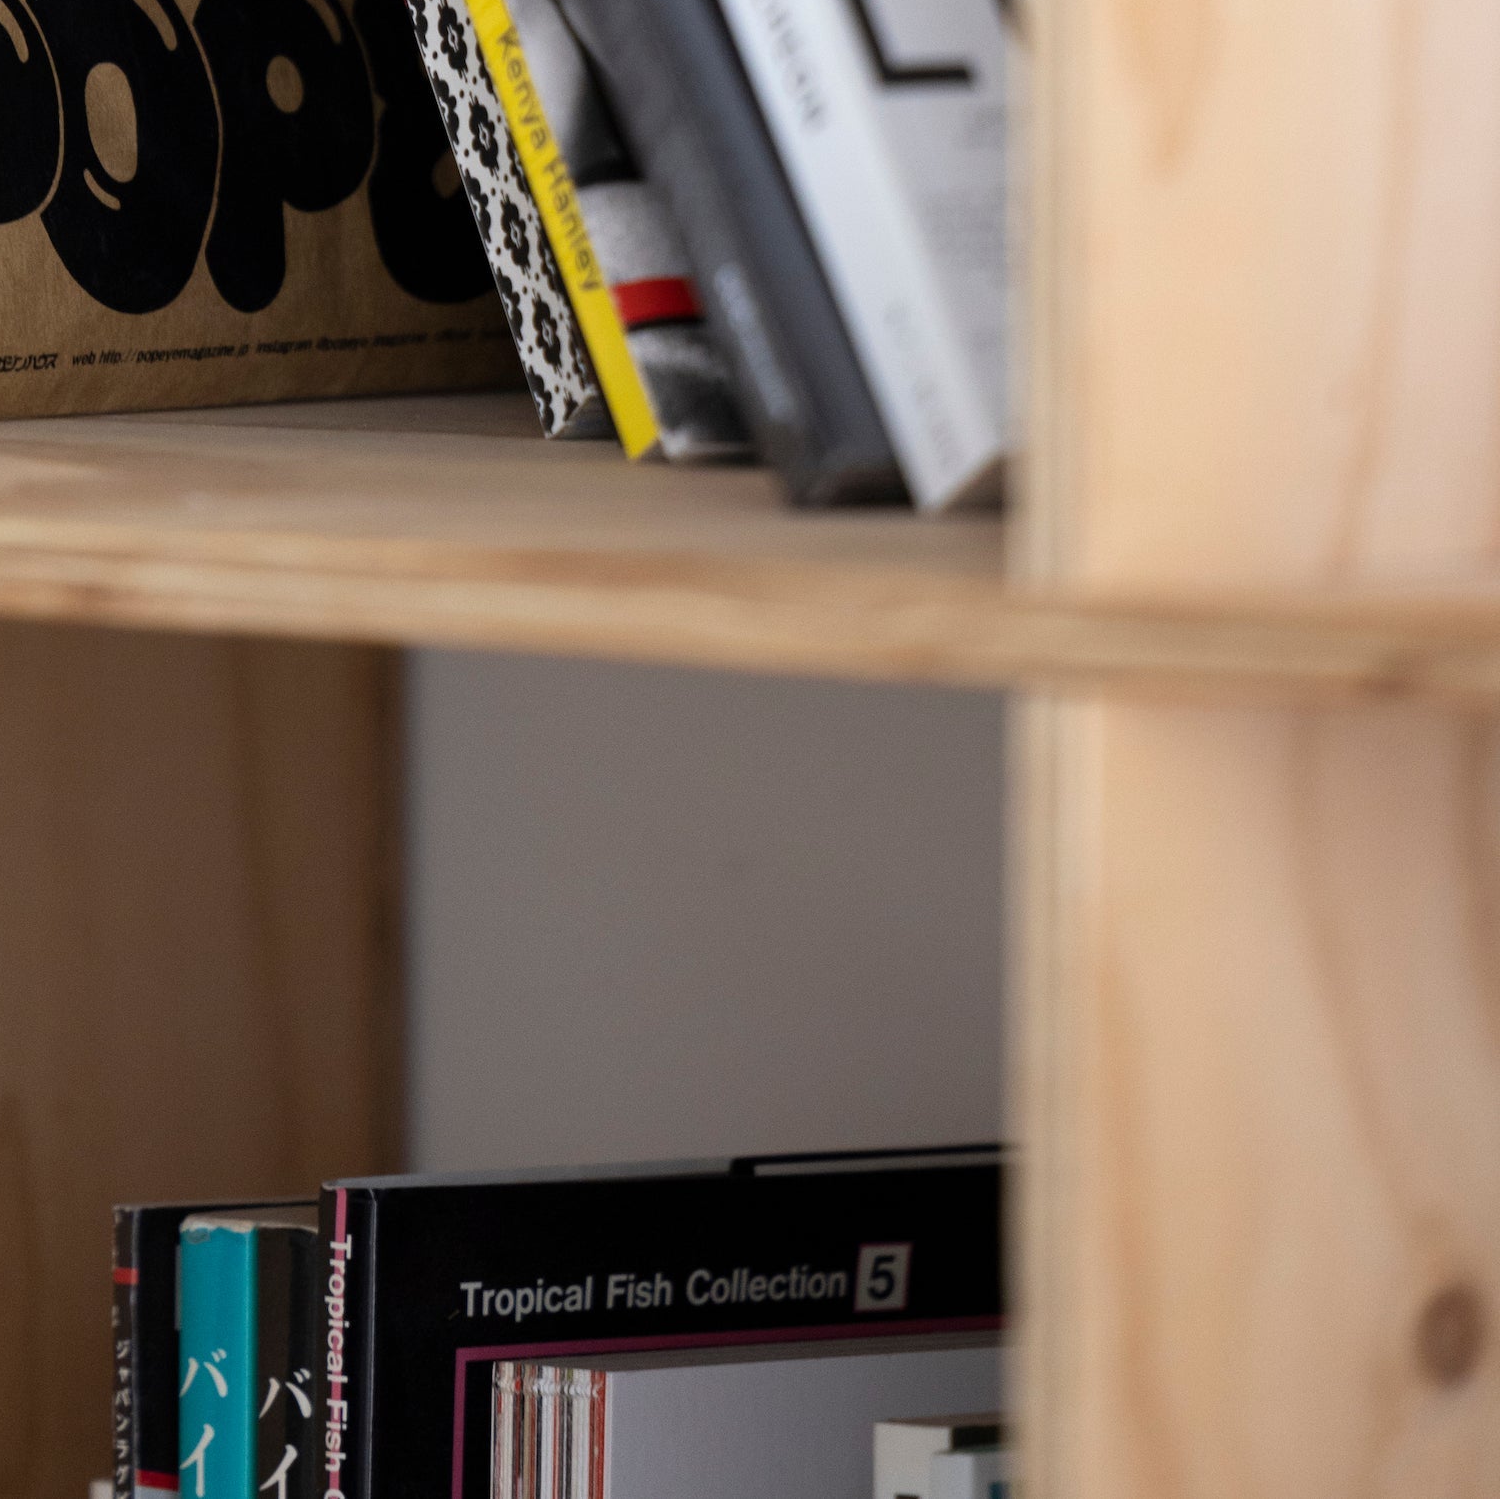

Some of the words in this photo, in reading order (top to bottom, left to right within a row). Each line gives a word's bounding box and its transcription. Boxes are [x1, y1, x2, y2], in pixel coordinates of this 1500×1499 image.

[497, 27, 547, 152] Kenya
[541, 153, 601, 294] Hanley
[72, 349, 96, 367] web
[325, 1234, 353, 1385] Tropical
[460, 1276, 592, 1319] Tropical
[606, 1273, 673, 1311] Fish
[687, 1265, 847, 1307] Collection
[866, 1256, 896, 1300] 5
[325, 1398, 348, 1472] Fish
